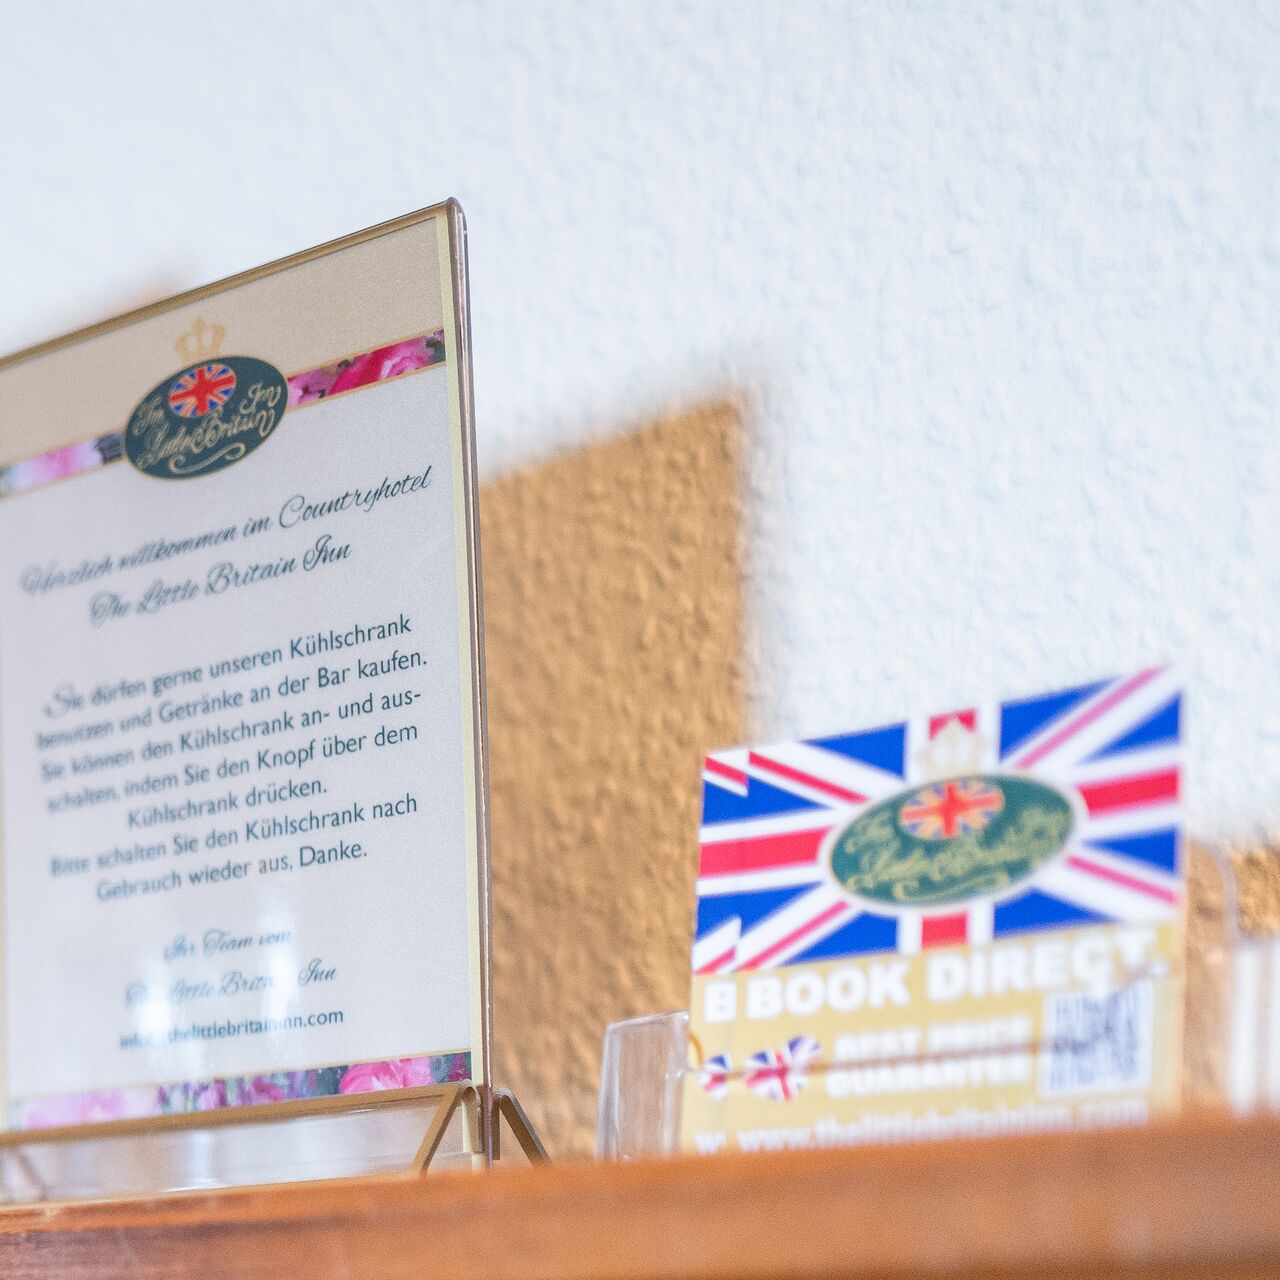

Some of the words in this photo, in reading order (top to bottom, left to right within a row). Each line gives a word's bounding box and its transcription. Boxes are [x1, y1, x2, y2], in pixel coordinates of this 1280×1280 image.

[242, 516, 272, 538] im
[279, 465, 433, 528] Countryhotel
[204, 556, 297, 596] Britain
[302, 533, 352, 571] Inn
[119, 706, 153, 733] und
[158, 686, 244, 724] Getränke
[250, 686, 272, 704] an
[278, 676, 311, 698] der
[317, 665, 351, 689] Bar
[357, 649, 428, 680] kaufen.
[152, 667, 203, 698] gerne
[209, 647, 283, 678] unseren
[289, 613, 413, 660] Kühlschrank
[124, 773, 179, 798] indem
[183, 763, 211, 787] Sie
[216, 757, 251, 780] den
[257, 737, 317, 770] Knopf
[322, 735, 368, 759] über
[374, 725, 418, 748] dem
[141, 740, 174, 762] den
[179, 710, 295, 753] Kühlschrank
[300, 709, 330, 729] an-
[338, 692, 374, 720] und
[380, 689, 422, 711] aus-
[97, 843, 167, 870] schalten
[173, 833, 199, 857] Sie
[205, 828, 239, 850] den
[245, 802, 366, 842] Kühlschrank
[372, 793, 418, 820] nach
[127, 792, 239, 830] Kühlschrank
[245, 779, 328, 808] drücken.
[96, 869, 183, 902] Gebrauch
[188, 859, 251, 886] wieder
[299, 840, 368, 869] Danke.
[297, 957, 338, 988] Inn
[744, 960, 912, 1019] BOOK
